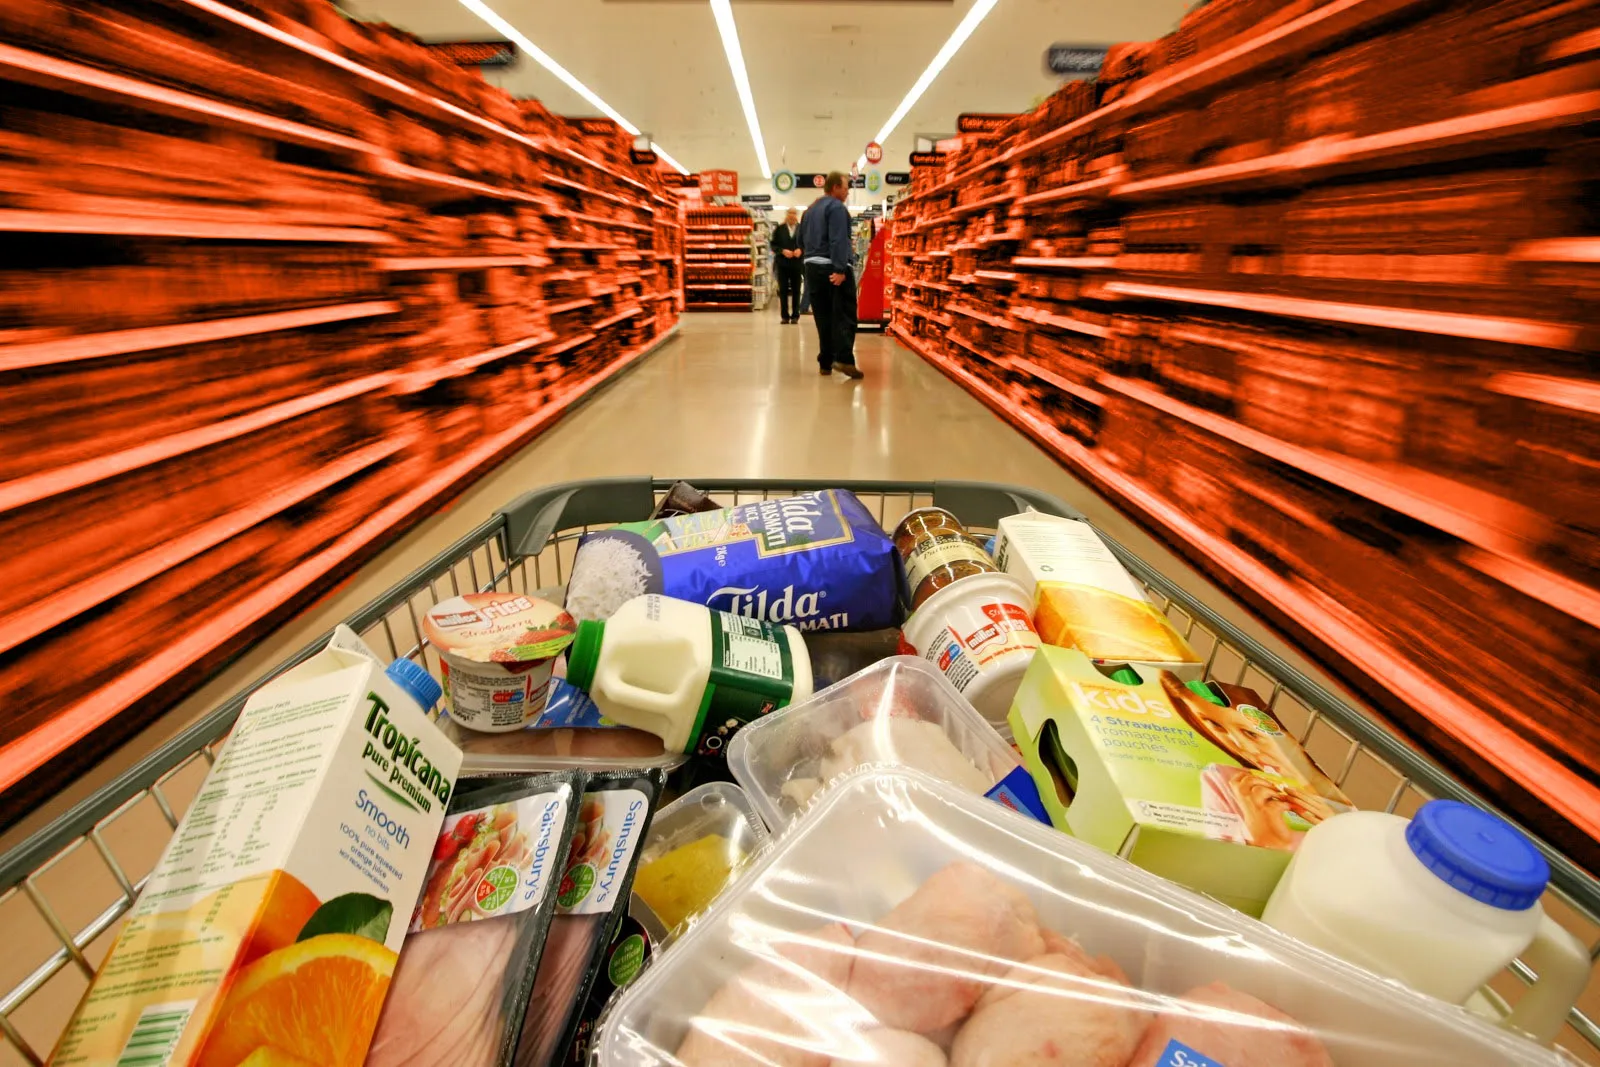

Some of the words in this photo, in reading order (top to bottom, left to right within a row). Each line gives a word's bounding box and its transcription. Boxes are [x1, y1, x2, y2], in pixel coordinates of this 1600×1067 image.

[706, 584, 820, 623] Tilda
[790, 613, 849, 632] MATI
[1071, 681, 1172, 719] kids
[1095, 725, 1161, 743] fromage
[1163, 734, 1199, 748] frais
[1103, 738, 1169, 754] pouches
[1106, 716, 1194, 739] Strawberry
[364, 690, 451, 812] Tropicana
[362, 741, 389, 773] pure
[389, 765, 431, 813] premium
[355, 789, 411, 849] Smooth
[365, 825, 376, 838] no
[377, 833, 391, 851] bits
[340, 822, 360, 844] 100%
[360, 841, 375, 856] pure
[375, 853, 404, 881] squeezed
[351, 845, 373, 866] orange
[372, 862, 387, 879] juice
[524, 800, 559, 901] Sainsbury's
[597, 800, 642, 903] Sainsbury's
